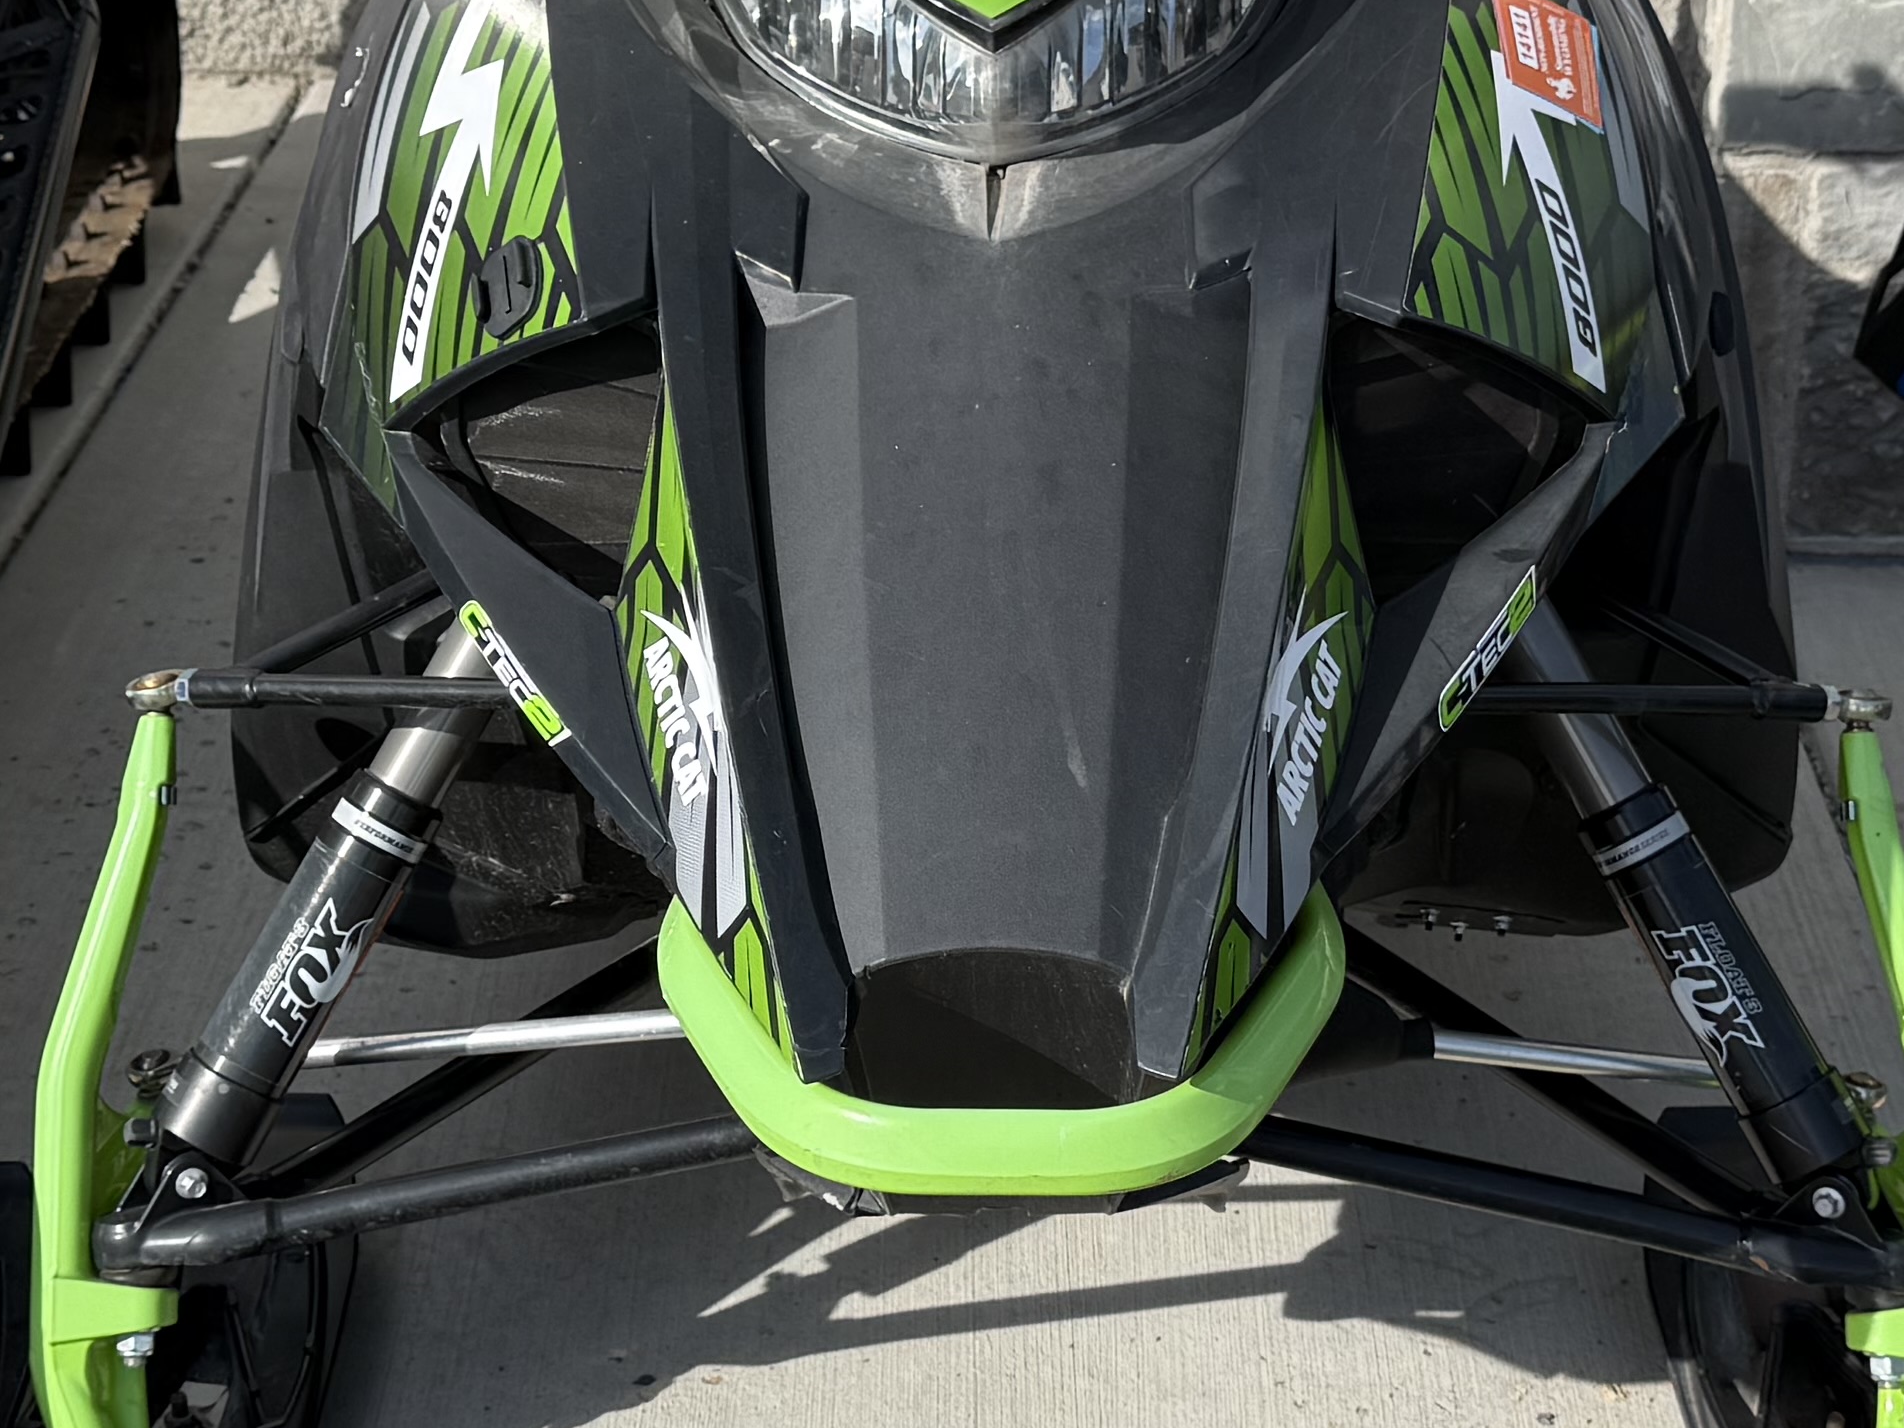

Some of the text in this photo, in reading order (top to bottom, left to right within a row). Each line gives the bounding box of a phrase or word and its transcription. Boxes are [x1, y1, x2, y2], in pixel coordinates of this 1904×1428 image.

[402, 189, 453, 366] 8000
[1535, 178, 1598, 358] 8000
[642, 636, 709, 807] ARCTIC CAT
[1276, 638, 1341, 827] ARCTIC CAT
[261, 897, 349, 1048] FOX
[1651, 925, 1766, 1052] FOX
[1698, 921, 1755, 996] FLOAT
